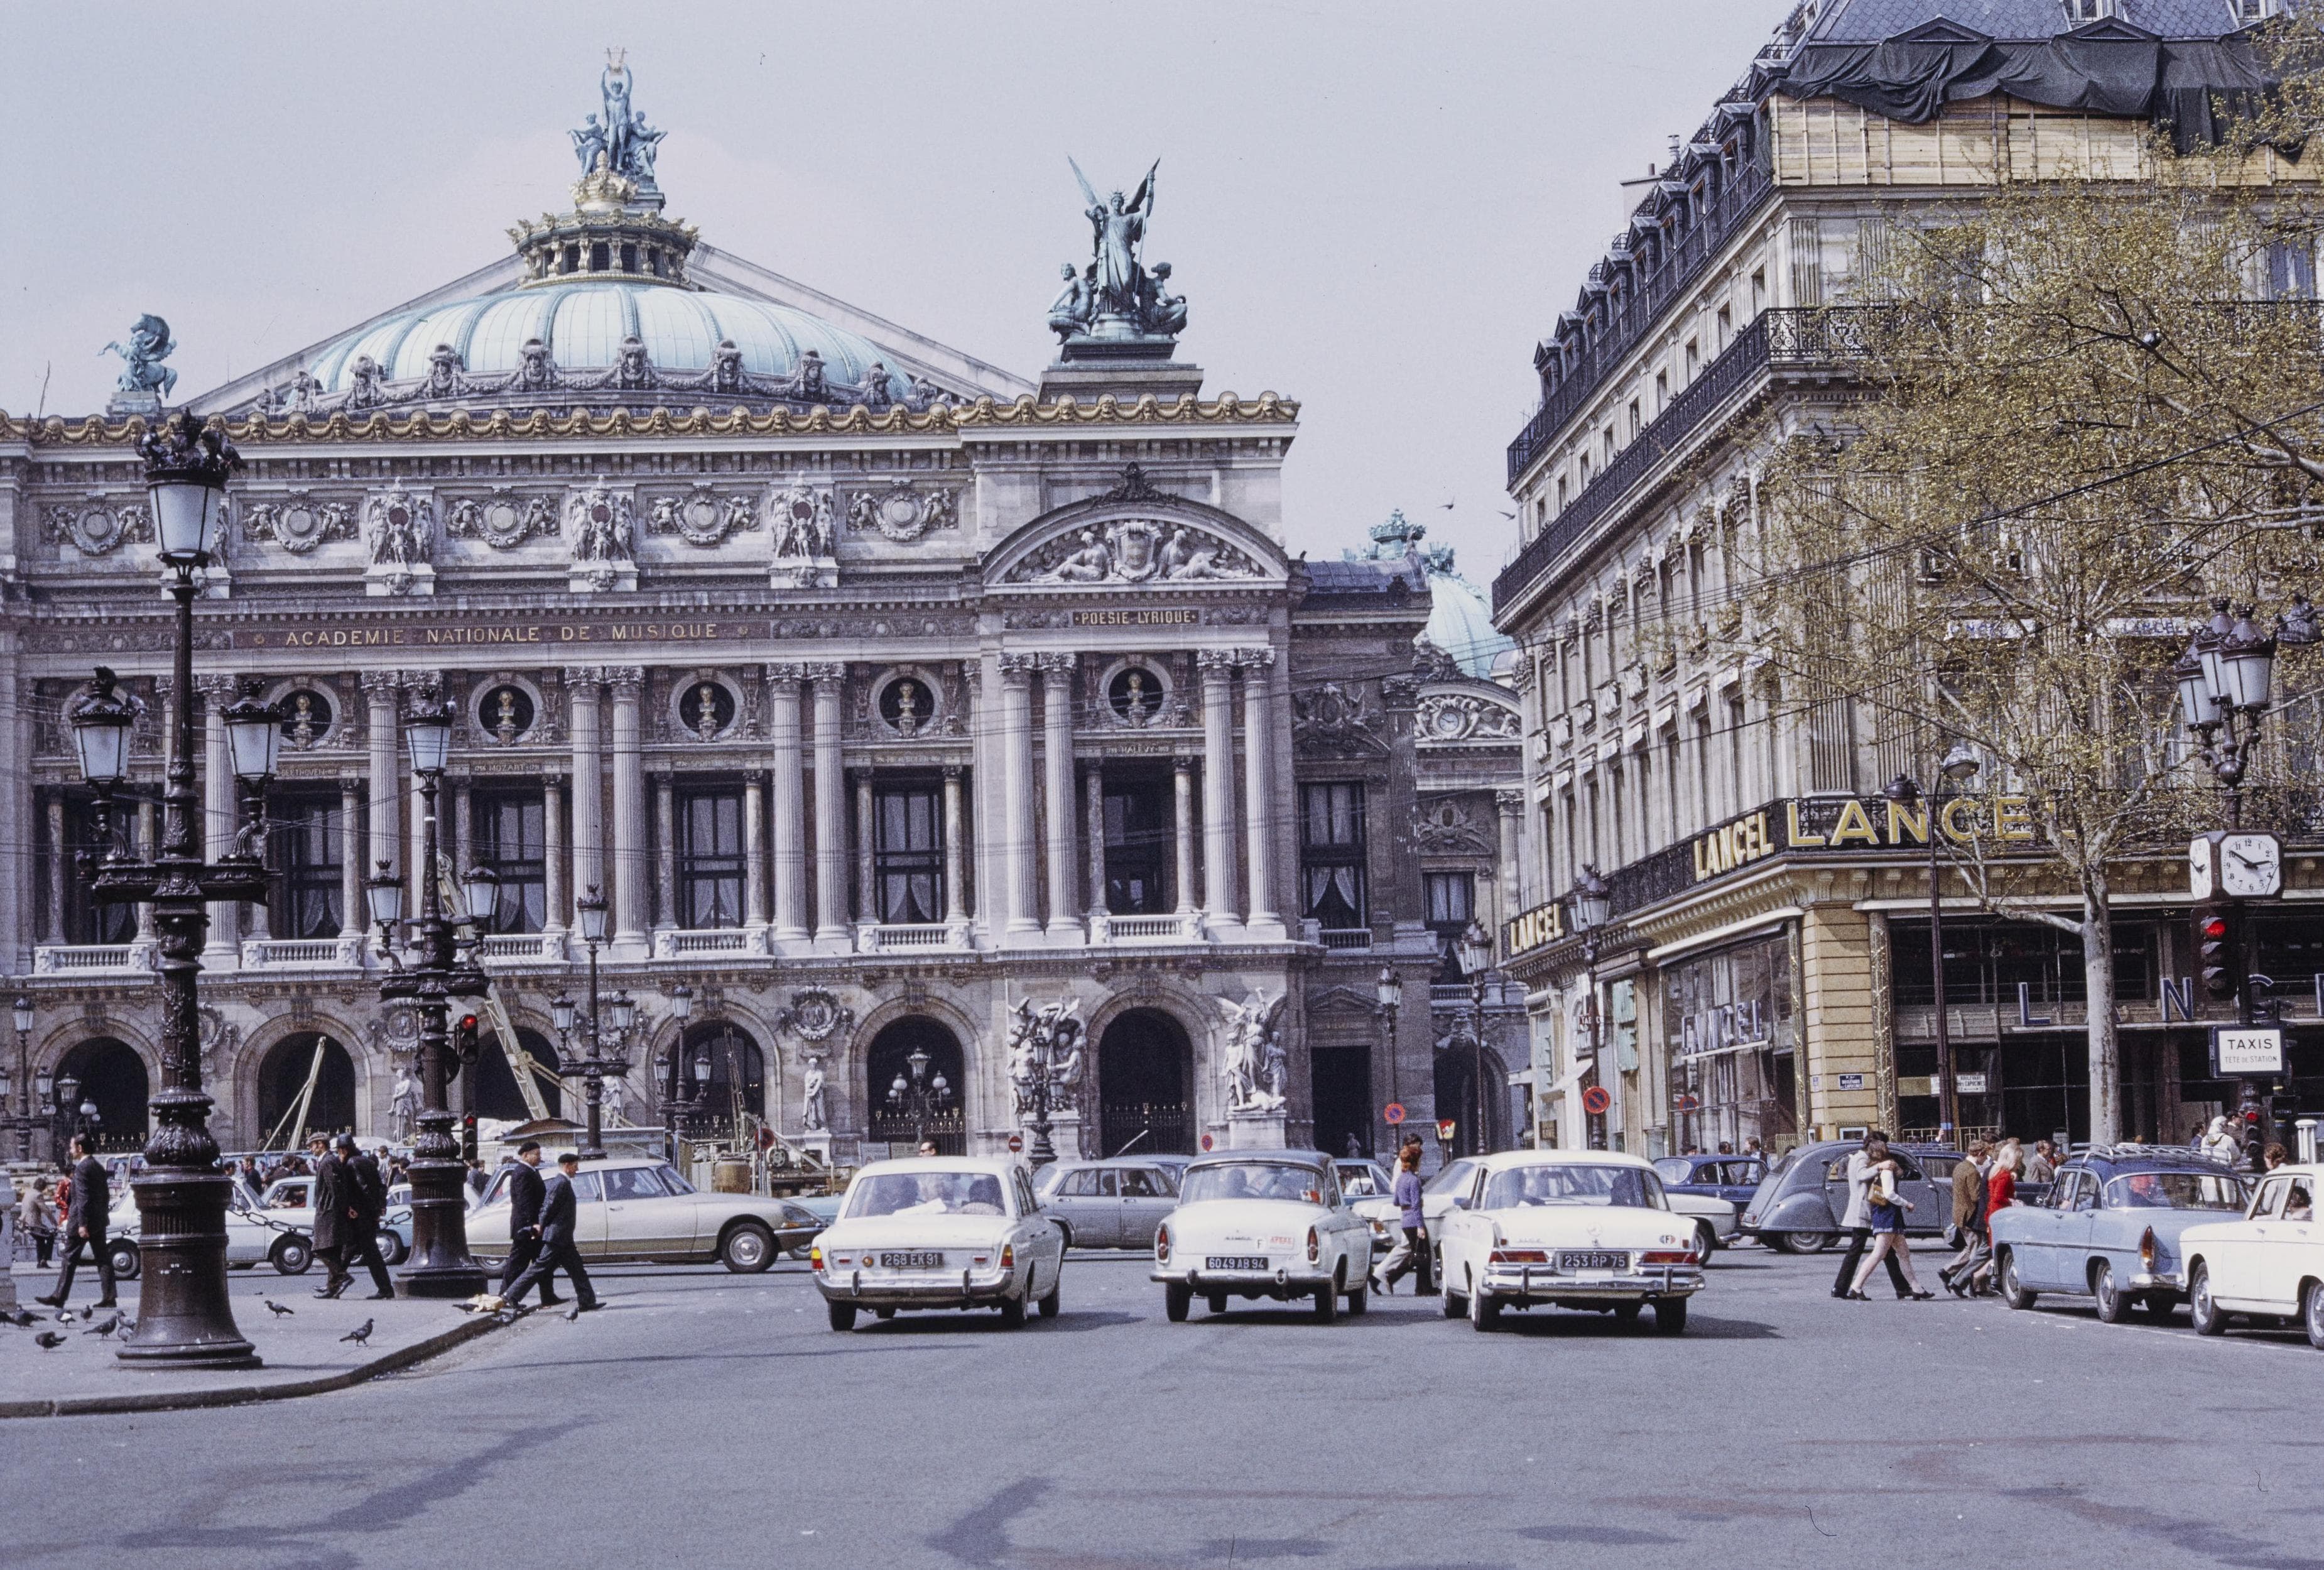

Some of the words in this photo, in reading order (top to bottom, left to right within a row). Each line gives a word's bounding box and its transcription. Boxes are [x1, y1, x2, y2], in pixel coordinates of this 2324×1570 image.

[1081, 611, 1129, 624] POESIE
[1138, 610, 1191, 624] LYRIQUE
[286, 630, 405, 646] ACADEMIE
[427, 627, 540, 643] NATIONALE
[561, 626, 590, 641] DE
[611, 623, 717, 640] MUSIQUE
[1694, 812, 1775, 881] LANCEL
[1510, 903, 1564, 956] LANCEL
[1581, 1016, 1600, 1025] TABC
[2227, 1038, 2273, 1050] TAXIS
[1257, 1239, 1264, 1249] F
[885, 1255, 908, 1266] 268
[910, 1254, 925, 1265] EK
[926, 1254, 938, 1265] 91
[1208, 1257, 1235, 1269] 6049
[1237, 1257, 1250, 1269] AB
[1251, 1257, 1264, 1269] 94
[1565, 1255, 1589, 1267] 253
[1590, 1255, 1607, 1267] RP
[1611, 1255, 1626, 1267] 75
